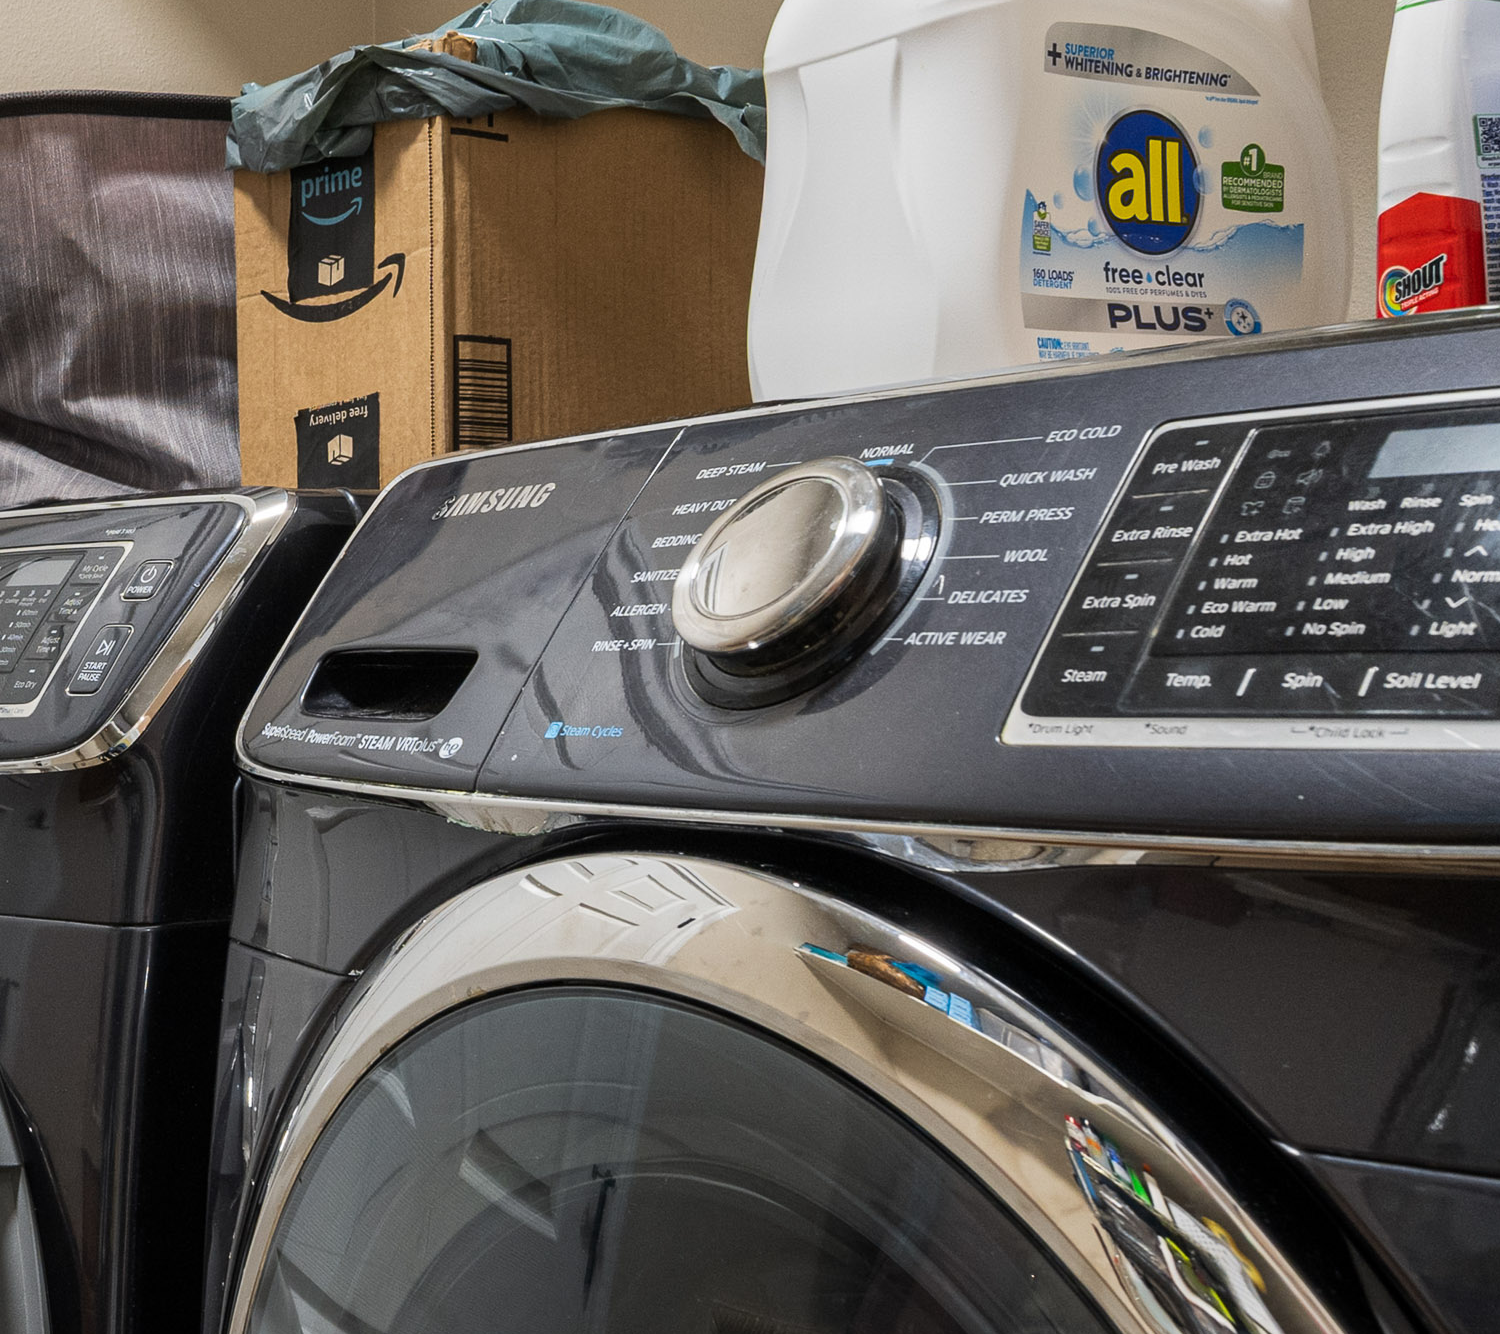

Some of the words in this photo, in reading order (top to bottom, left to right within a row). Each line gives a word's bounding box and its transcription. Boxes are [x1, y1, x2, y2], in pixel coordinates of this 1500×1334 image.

[1065, 43, 1115, 60] SUPERIOR
[1065, 56, 1133, 77] WHITENING
[1243, 148, 1257, 171] #1
[301, 166, 363, 207] prime
[1108, 139, 1184, 224] all
[1223, 177, 1283, 188] RECOMMENDED
[1230, 187, 1282, 196] DERMATOLOGISTS
[1034, 220, 1050, 228] SAFER
[1033, 268, 1045, 279] 160
[1104, 261, 1143, 284] free
[1155, 265, 1204, 288] clear
[1395, 255, 1444, 301] SHOUT
[1033, 278, 1072, 289] DETERGENT
[1106, 286, 1121, 294] 100%
[1123, 287, 1138, 295] FREE
[1150, 288, 1183, 297] PERFUMES
[1401, 296, 1418, 308] TRIPLE
[1419, 287, 1439, 300] ACTING
[309, 410, 347, 427] delivery
[349, 405, 368, 418] free
[1046, 428, 1077, 443] ECO
[1079, 425, 1122, 440] COLD
[860, 443, 914, 459] NORMAL
[696, 467, 727, 480] DEEP
[729, 462, 766, 475] STEAM
[1152, 460, 1178, 475] Pre
[1181, 456, 1221, 472] Wash
[1000, 471, 1048, 487] QUICK
[1050, 468, 1097, 482] WASH
[432, 483, 556, 520] SAMSUNG
[672, 502, 710, 515] HEAVY
[711, 498, 736, 512] DUT
[1348, 499, 1387, 511] Wash
[1401, 497, 1442, 509] Rinse
[1459, 494, 1495, 507] Spin
[979, 510, 1023, 524] PERM
[1026, 507, 1075, 521] PRESS
[1111, 529, 1150, 543] Extra
[1152, 524, 1194, 539] Rinse
[1347, 523, 1392, 536] Extra
[1393, 520, 1435, 536] High
[652, 534, 702, 548] BEDDING
[1234, 530, 1274, 543] Extra
[1274, 528, 1303, 541] Hot
[1004, 549, 1048, 563] WOOL
[1223, 554, 1253, 566] Hot
[1335, 547, 1376, 562] High
[630, 569, 680, 583] SANITIZE
[1324, 572, 1391, 585] Medium
[1213, 578, 1258, 589] Warm
[64, 598, 83, 607] Adjust
[948, 589, 1029, 604] DELICATES
[1082, 595, 1121, 610] Extra
[1122, 593, 1156, 609] Spin
[611, 603, 667, 617] ALLERGEN
[1201, 602, 1229, 614] Eco
[1231, 601, 1277, 612] Warm
[1312, 598, 1349, 611] Low
[1190, 625, 1226, 638] Cold
[1302, 623, 1327, 635] No
[1328, 622, 1366, 637] Spin
[1429, 622, 1478, 637] Light
[904, 632, 958, 645] ACTIVE
[960, 631, 1007, 644] WEAR
[592, 639, 656, 652] RINSE+SPIN
[78, 673, 101, 681] PAUSE
[1061, 669, 1107, 683] Steam
[1166, 673, 1212, 689] Temp.
[1281, 673, 1323, 689] Spin
[1383, 673, 1424, 689] Soil
[1424, 673, 1482, 689] Level
[25, 681, 37, 689] Dry
[262, 722, 307, 741] SuperSpeed
[359, 735, 395, 751] STEAM
[560, 724, 590, 736] Steam
[592, 724, 623, 738] Cycles
[1065, 724, 1094, 735] Light
[1353, 727, 1386, 739] Lock
